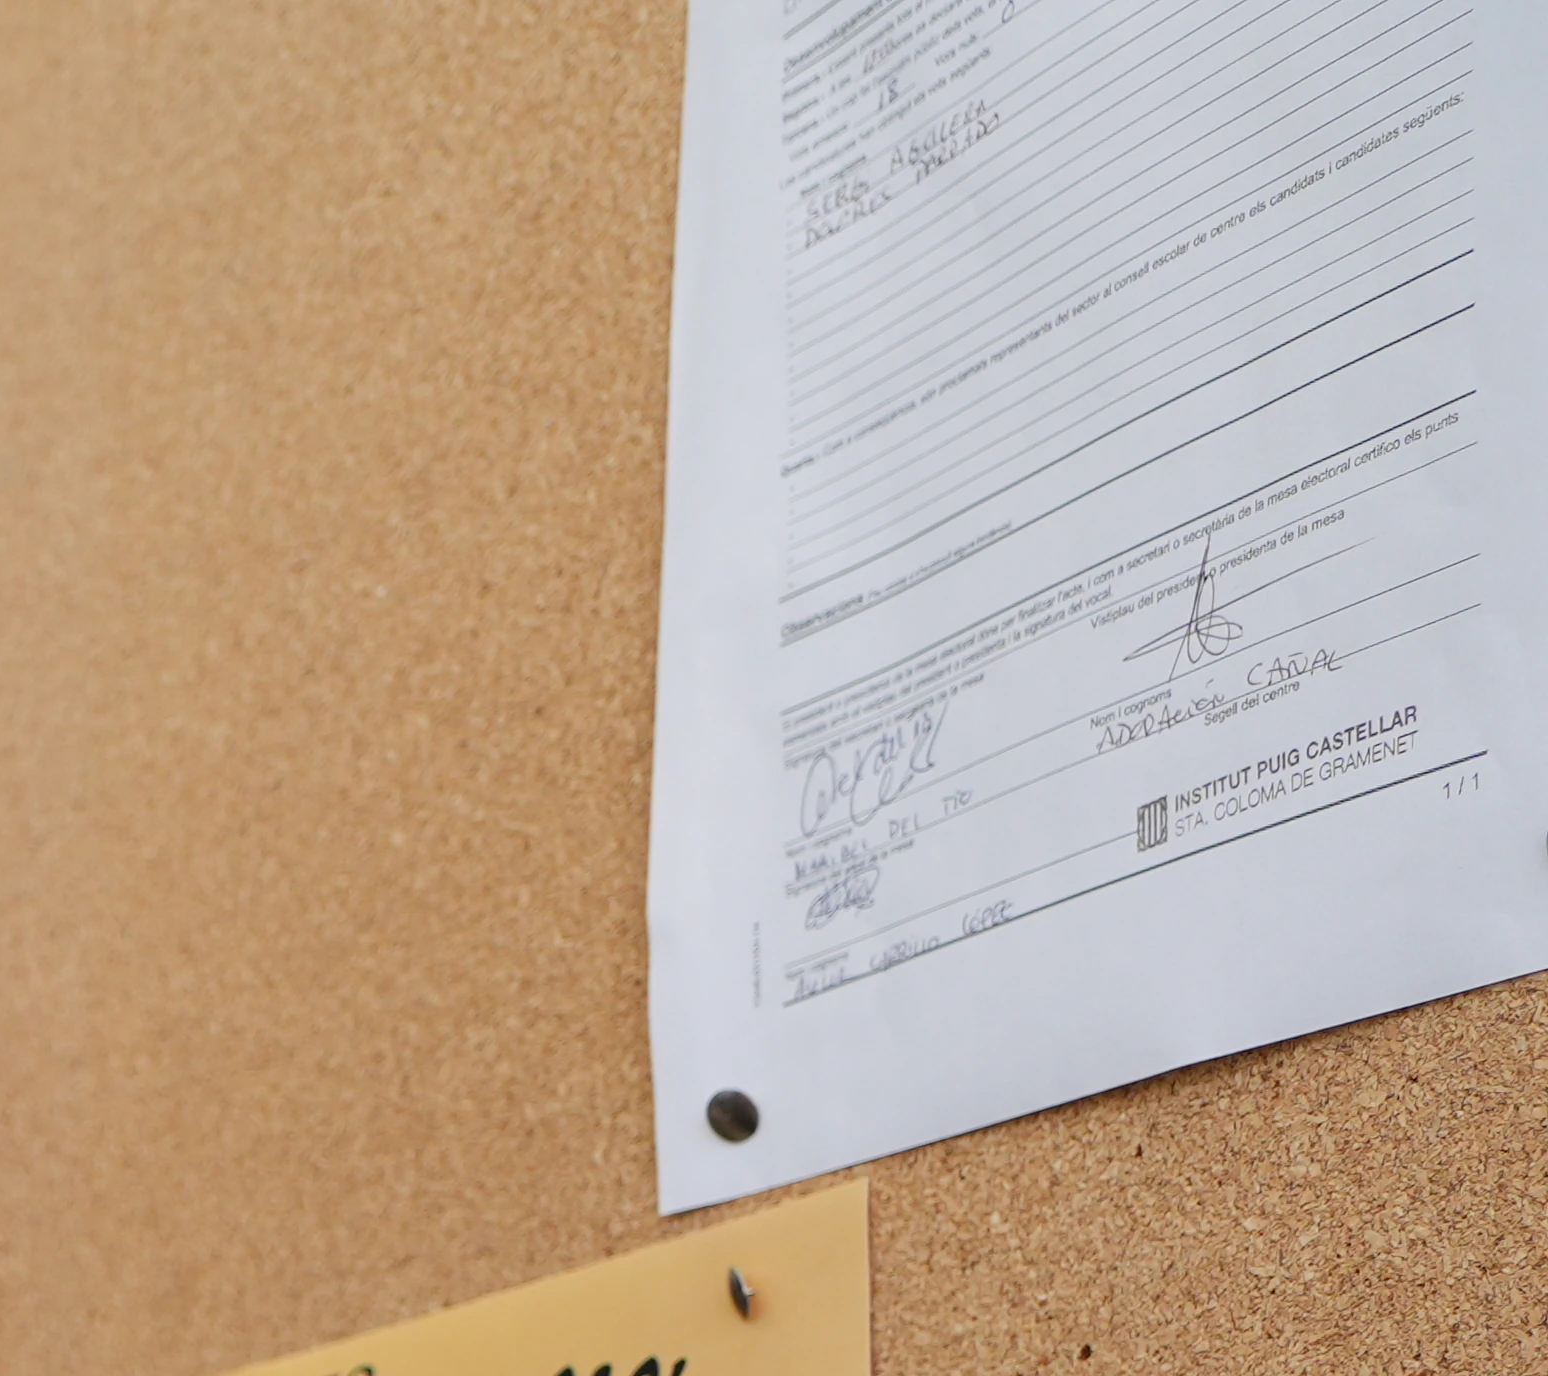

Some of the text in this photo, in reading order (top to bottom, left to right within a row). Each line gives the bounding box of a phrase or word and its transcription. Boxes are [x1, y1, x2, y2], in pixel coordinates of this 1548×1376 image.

[1055, 309, 1070, 327] del
[1072, 293, 1100, 318] sector
[1103, 283, 1112, 299] al
[1114, 260, 1149, 292] consell
[1152, 241, 1190, 270] escolar
[1193, 232, 1207, 247] de
[1210, 212, 1245, 238] centre
[1249, 200, 1266, 218] els
[1269, 169, 1326, 207] candidats
[1328, 162, 1332, 175] i
[1335, 127, 1399, 171] candidates
[1402, 91, 1465, 133] següents:
[1093, 570, 1115, 585] com
[1117, 566, 1124, 576] a
[1126, 544, 1171, 571] secretari
[1173, 539, 1181, 550] o
[1183, 513, 1235, 545] secretària
[1238, 504, 1252, 520] de
[1255, 499, 1265, 513] la
[1267, 483, 1298, 506] mesa
[1301, 457, 1351, 490] electoral
[1354, 440, 1400, 467] certifico
[1404, 428, 1422, 445] els
[1425, 411, 1459, 440] punts
[1090, 603, 1135, 630] Vistiplau
[1137, 591, 1155, 609] del
[1209, 566, 1216, 578] o
[1219, 536, 1277, 573] presidenta
[1280, 531, 1295, 545] de
[1298, 522, 1308, 537] la
[1311, 508, 1345, 531] mesa
[1090, 688, 1172, 730] Nom i cognoms
[1174, 704, 1418, 814] INSTITUT PUIG CASTELLAR
[1204, 681, 1300, 727] Segell del centre
[1174, 729, 1420, 837] STA. COLOMA DE GRAMENET
